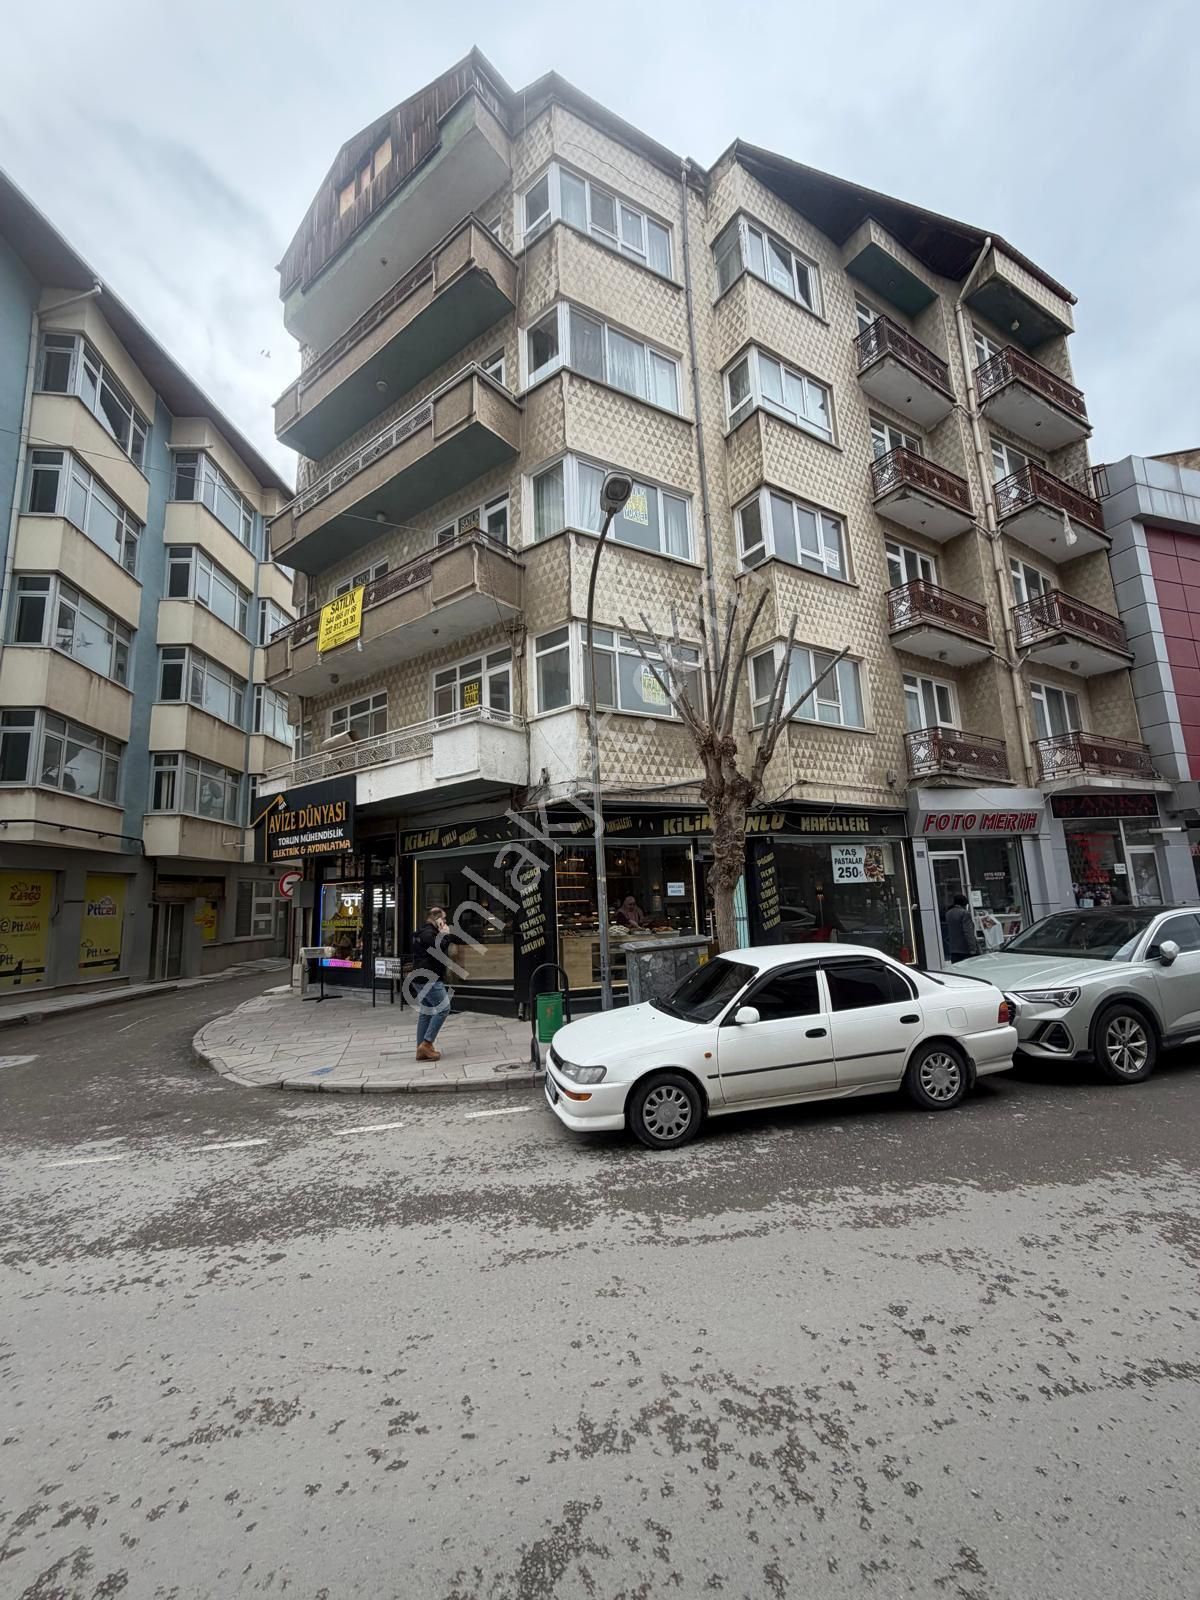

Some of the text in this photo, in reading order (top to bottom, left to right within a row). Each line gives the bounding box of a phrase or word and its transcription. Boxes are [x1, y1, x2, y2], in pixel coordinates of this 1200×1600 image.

[331, 592, 355, 614] SATILIK
[268, 801, 346, 833] AVİZE DÜNYASI
[744, 812, 785, 832] NLU
[923, 813, 977, 833] FOTO
[278, 827, 344, 846] TORUN MÜHENDİSLİK
[272, 845, 300, 858] ELEKTRİK
[307, 840, 351, 853] AYDINLATMA
[839, 848, 857, 857] YAŞ
[834, 857, 863, 865] PASTALAR
[9, 891, 41, 901] KARGO
